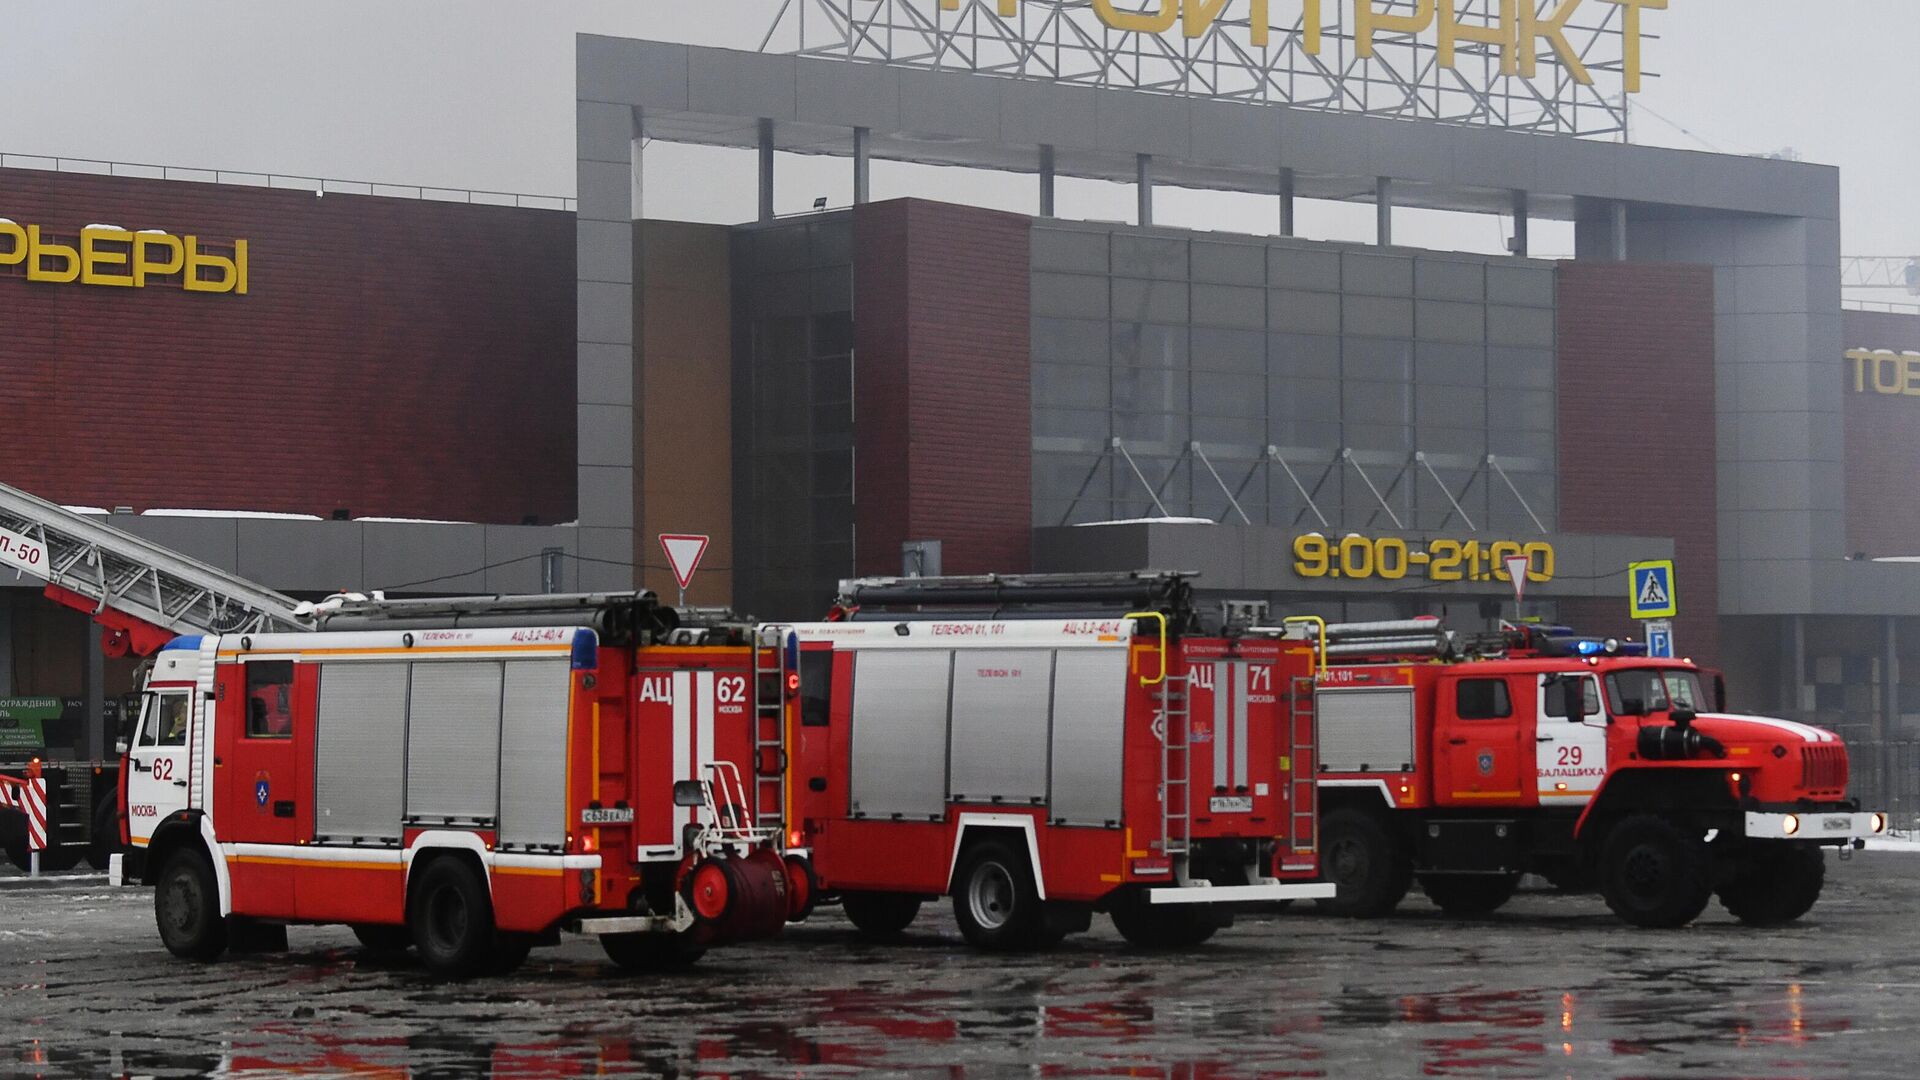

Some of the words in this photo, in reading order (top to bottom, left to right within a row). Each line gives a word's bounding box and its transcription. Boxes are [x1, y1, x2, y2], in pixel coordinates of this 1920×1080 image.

[1293, 535, 1554, 582] 9:00-21:00
[931, 624, 974, 635] ТЕЛЕФОН
[990, 624, 1006, 634] 101
[1188, 665, 1214, 691] АЦ
[1250, 665, 1271, 691] 71
[640, 677, 672, 705] АЦ
[717, 676, 746, 702] 62
[1557, 746, 1582, 765] 29
[153, 758, 173, 780] 62
[1537, 768, 1605, 777] БАЛАШИХА
[131, 805, 157, 816] МОСКВА
